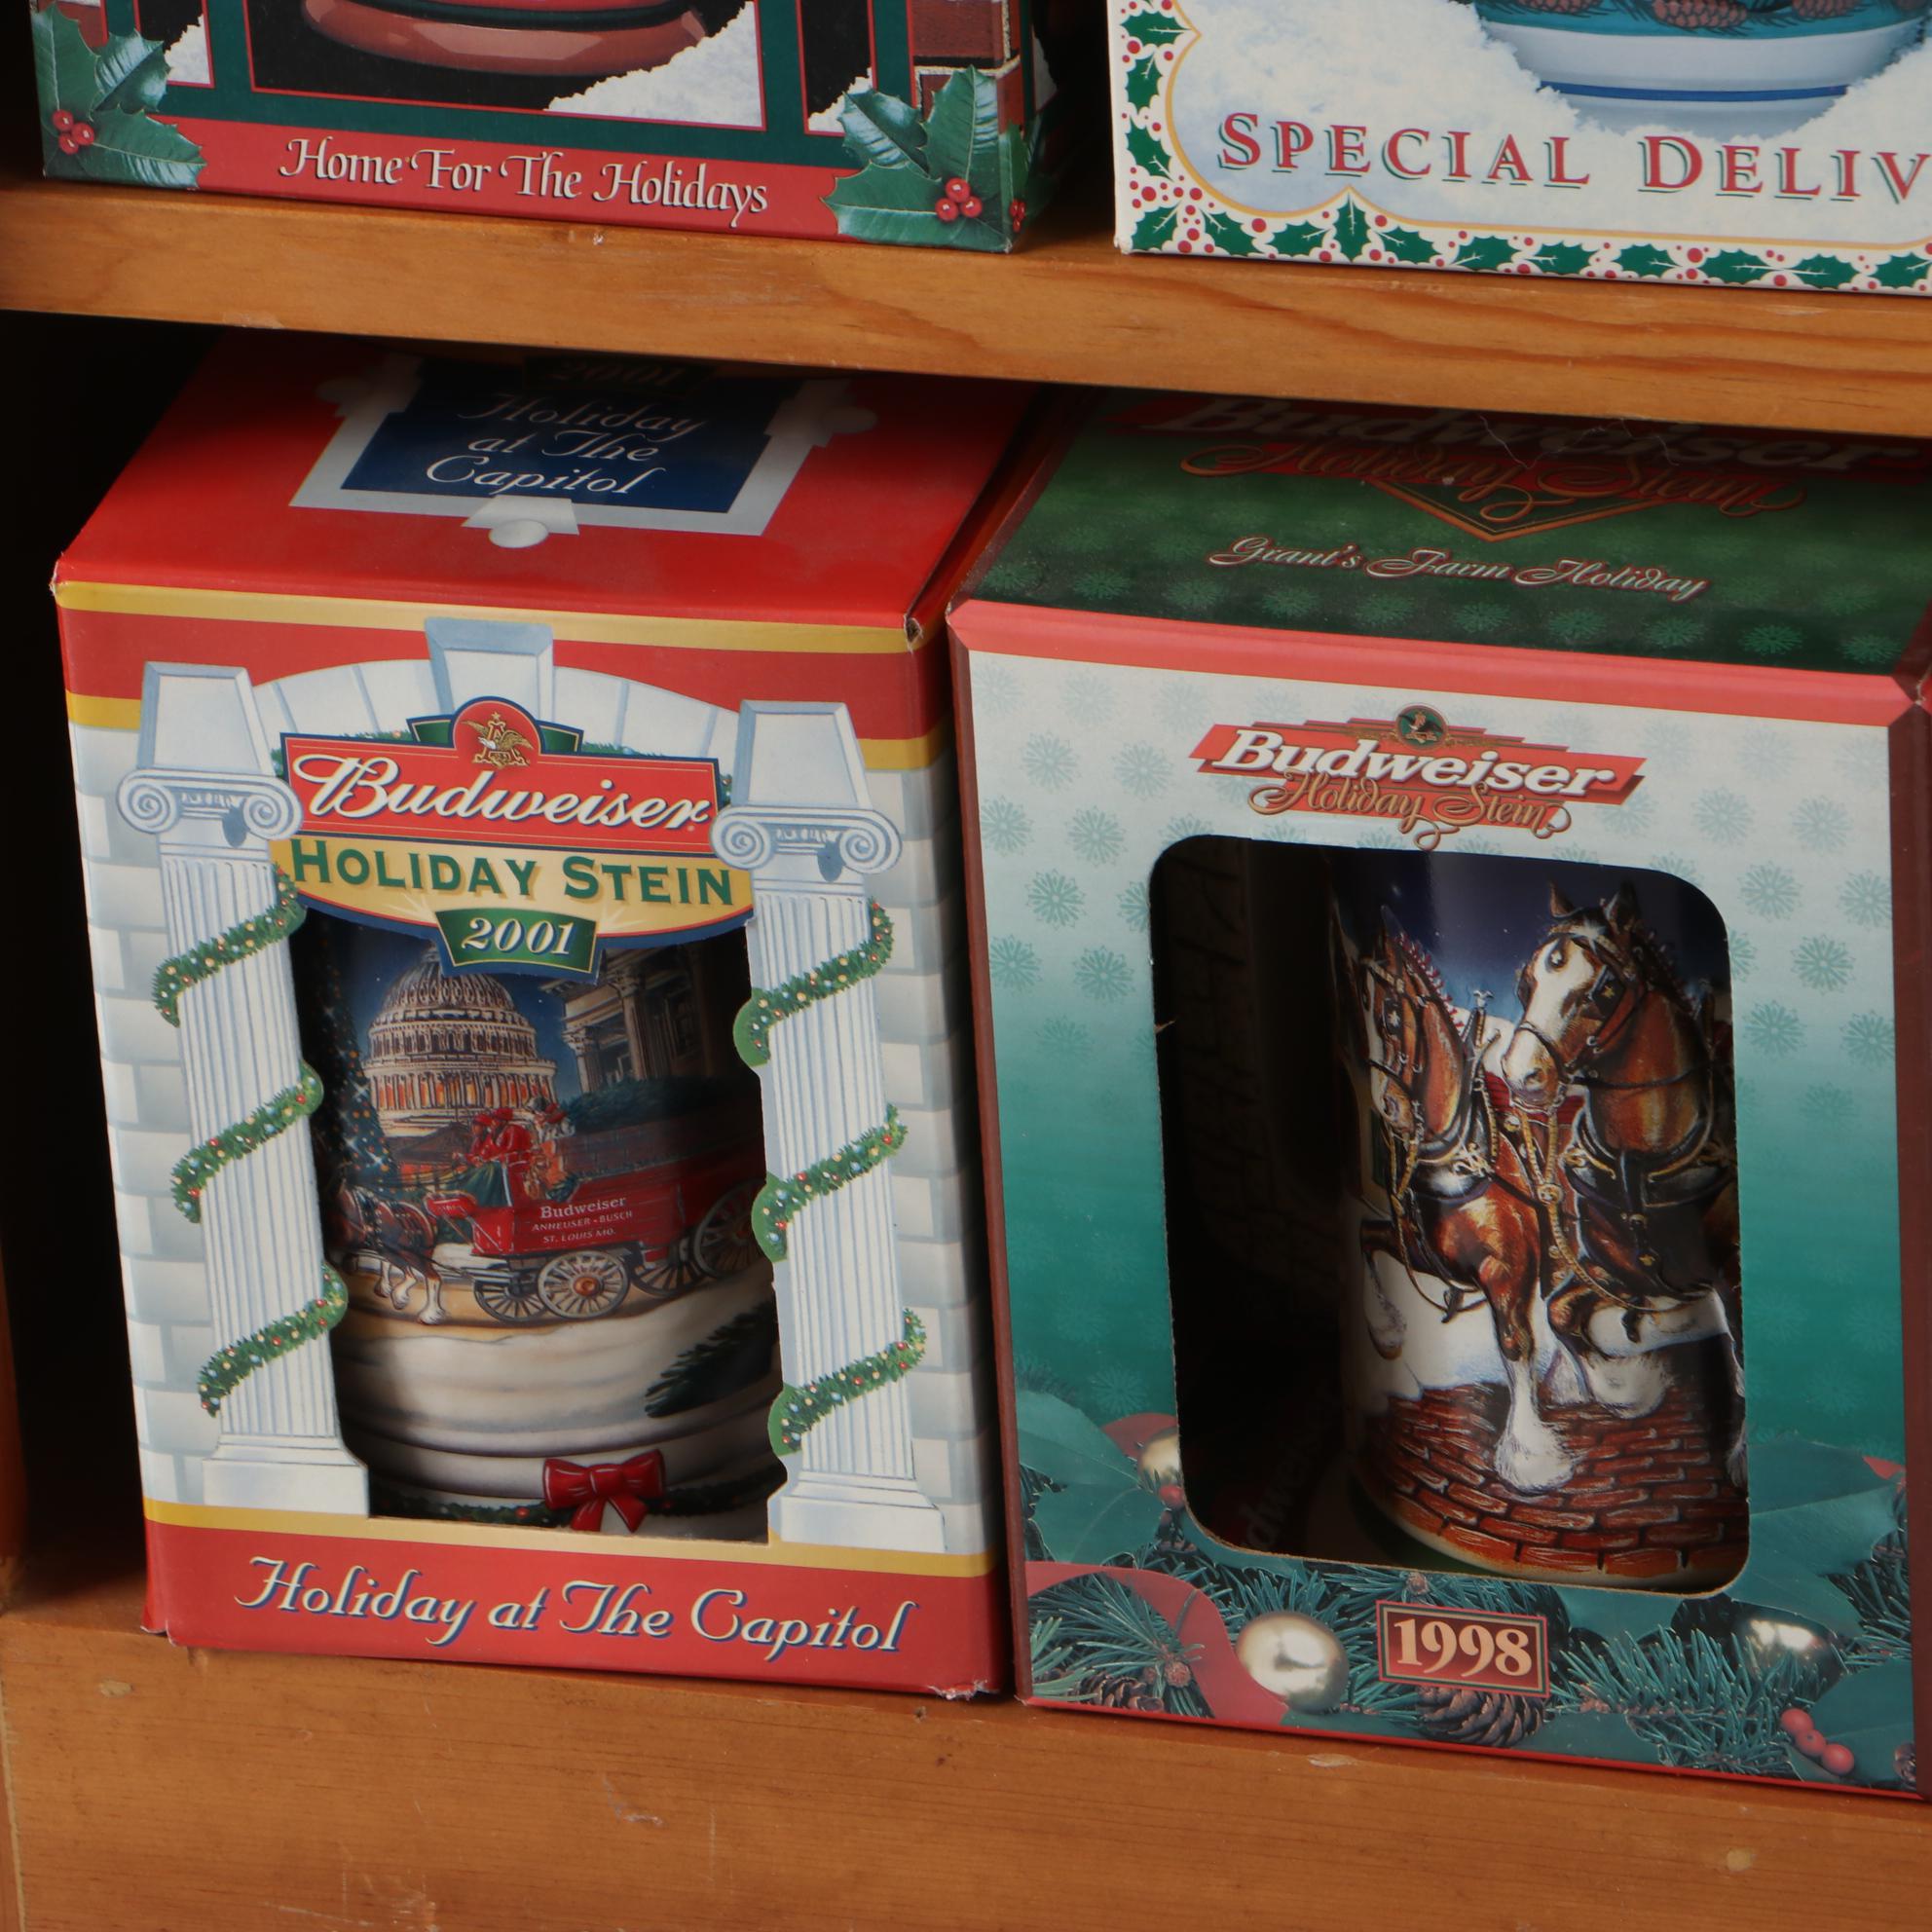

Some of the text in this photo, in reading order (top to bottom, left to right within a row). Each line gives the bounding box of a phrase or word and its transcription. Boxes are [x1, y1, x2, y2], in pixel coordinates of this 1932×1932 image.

[278, 135, 769, 229] Home For The Holidays
[1217, 111, 1590, 189] SPECIAL
[457, 392, 710, 443] Holiday
[467, 428, 660, 463] at The
[1161, 397, 1918, 470] Budweiser
[426, 455, 667, 496] Capitol
[1208, 536, 1710, 603] Grant's Farm Holiday
[292, 753, 712, 832] Budweiser
[1211, 728, 1617, 798] Budweiser
[1247, 768, 1573, 851] Holiday Stein
[290, 836, 735, 907] HOLIDAY STEIN
[460, 916, 575, 957] 2001
[539, 1196, 628, 1219] Budweiser
[561, 1231, 594, 1243] LOUIS
[234, 1555, 920, 1662] Holiday at The Capitol
[1393, 1617, 1533, 1678] 1998
